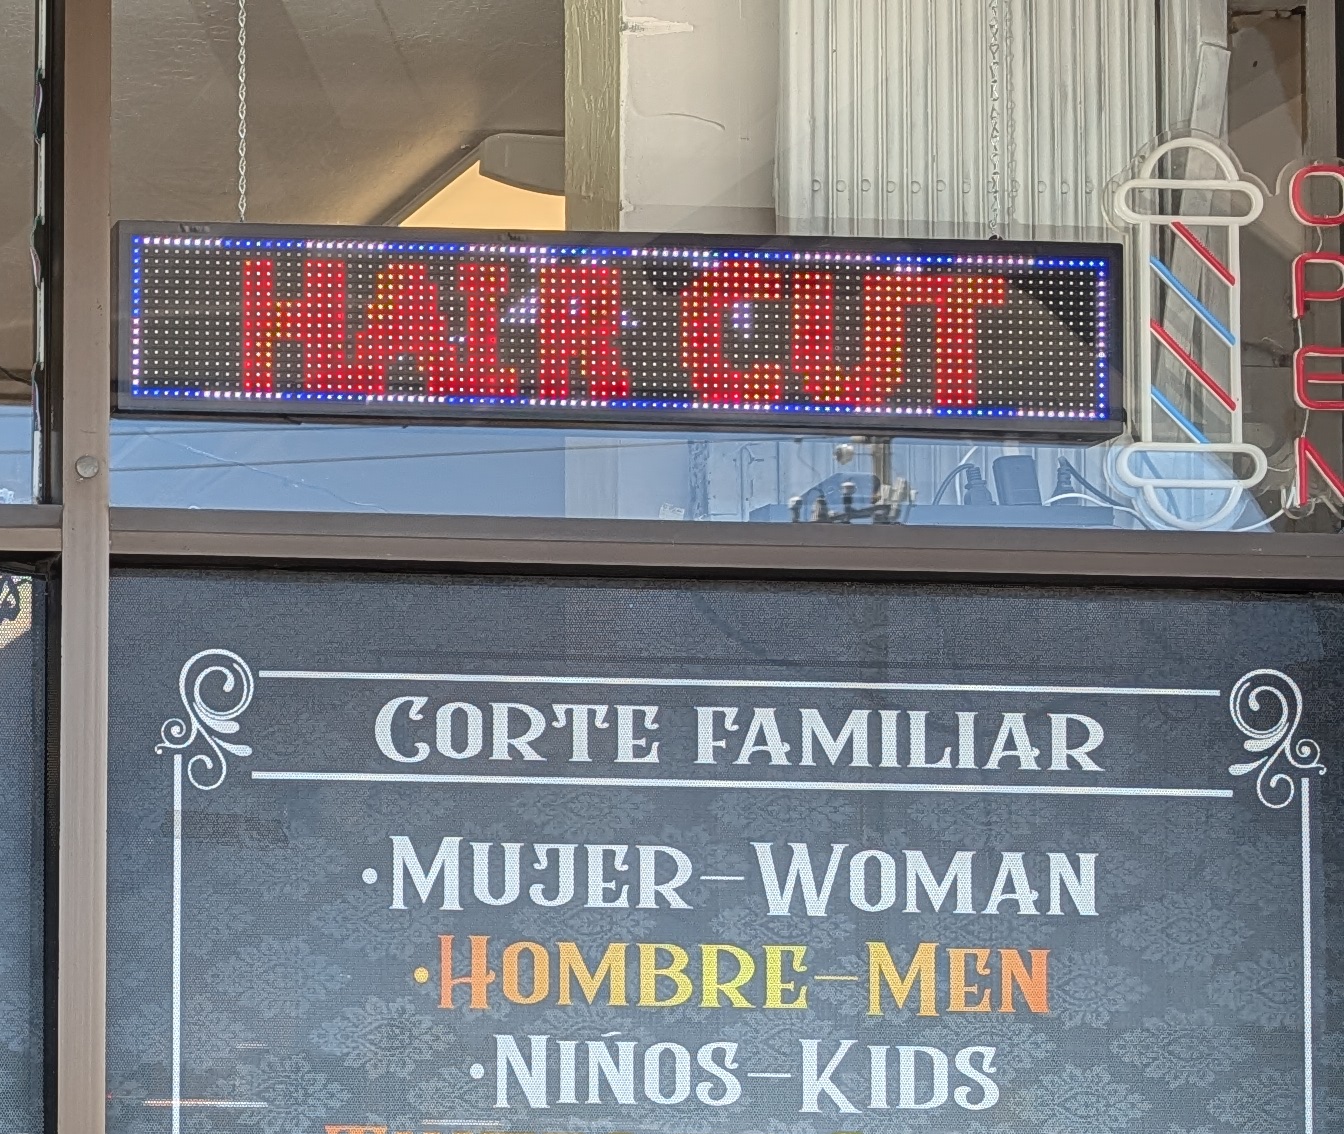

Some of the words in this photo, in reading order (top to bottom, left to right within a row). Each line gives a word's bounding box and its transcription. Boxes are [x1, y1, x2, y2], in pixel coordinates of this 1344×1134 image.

[241, 258, 631, 401] HAIR
[679, 261, 1009, 406] CUT
[373, 694, 661, 768] CORTE
[693, 704, 1107, 773] FAMILIAR
